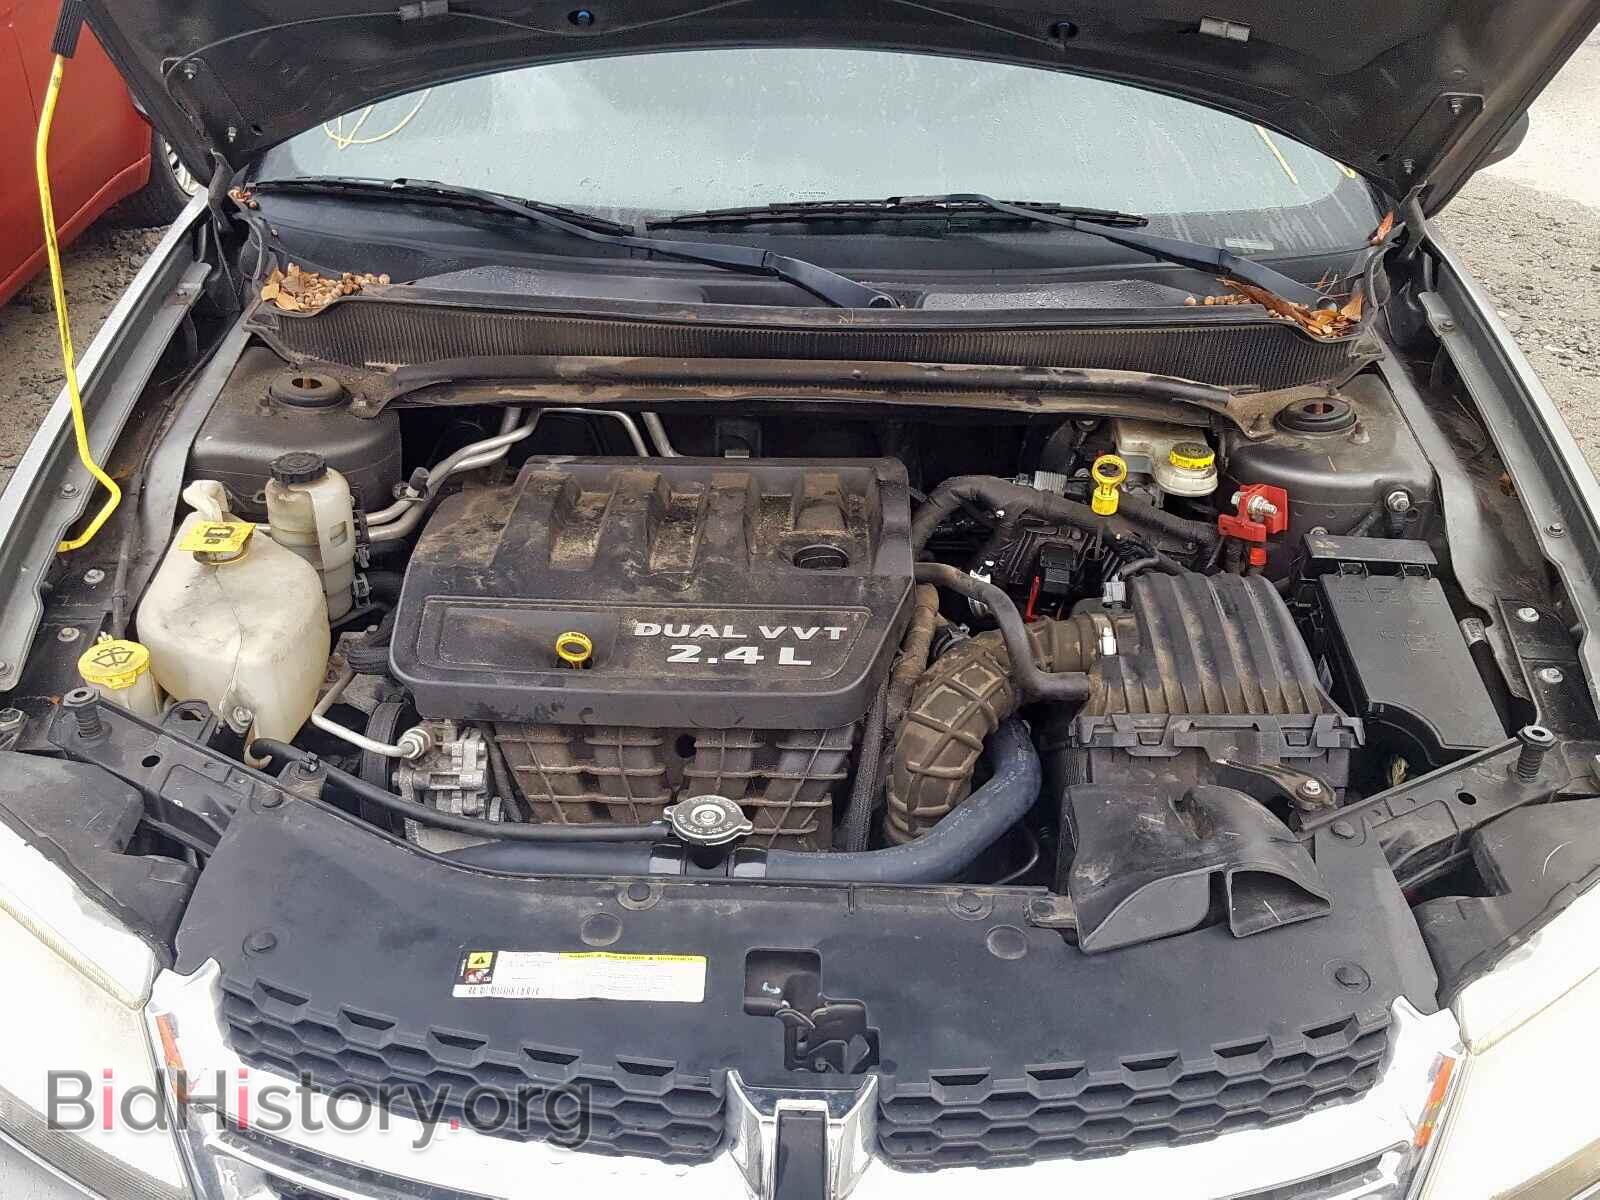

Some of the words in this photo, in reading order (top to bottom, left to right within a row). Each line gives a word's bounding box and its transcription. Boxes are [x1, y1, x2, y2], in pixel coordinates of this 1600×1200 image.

[632, 622, 748, 638] DUAL
[758, 625, 848, 640] VVT
[666, 644, 765, 665] 2.4
[778, 646, 812, 666] L
